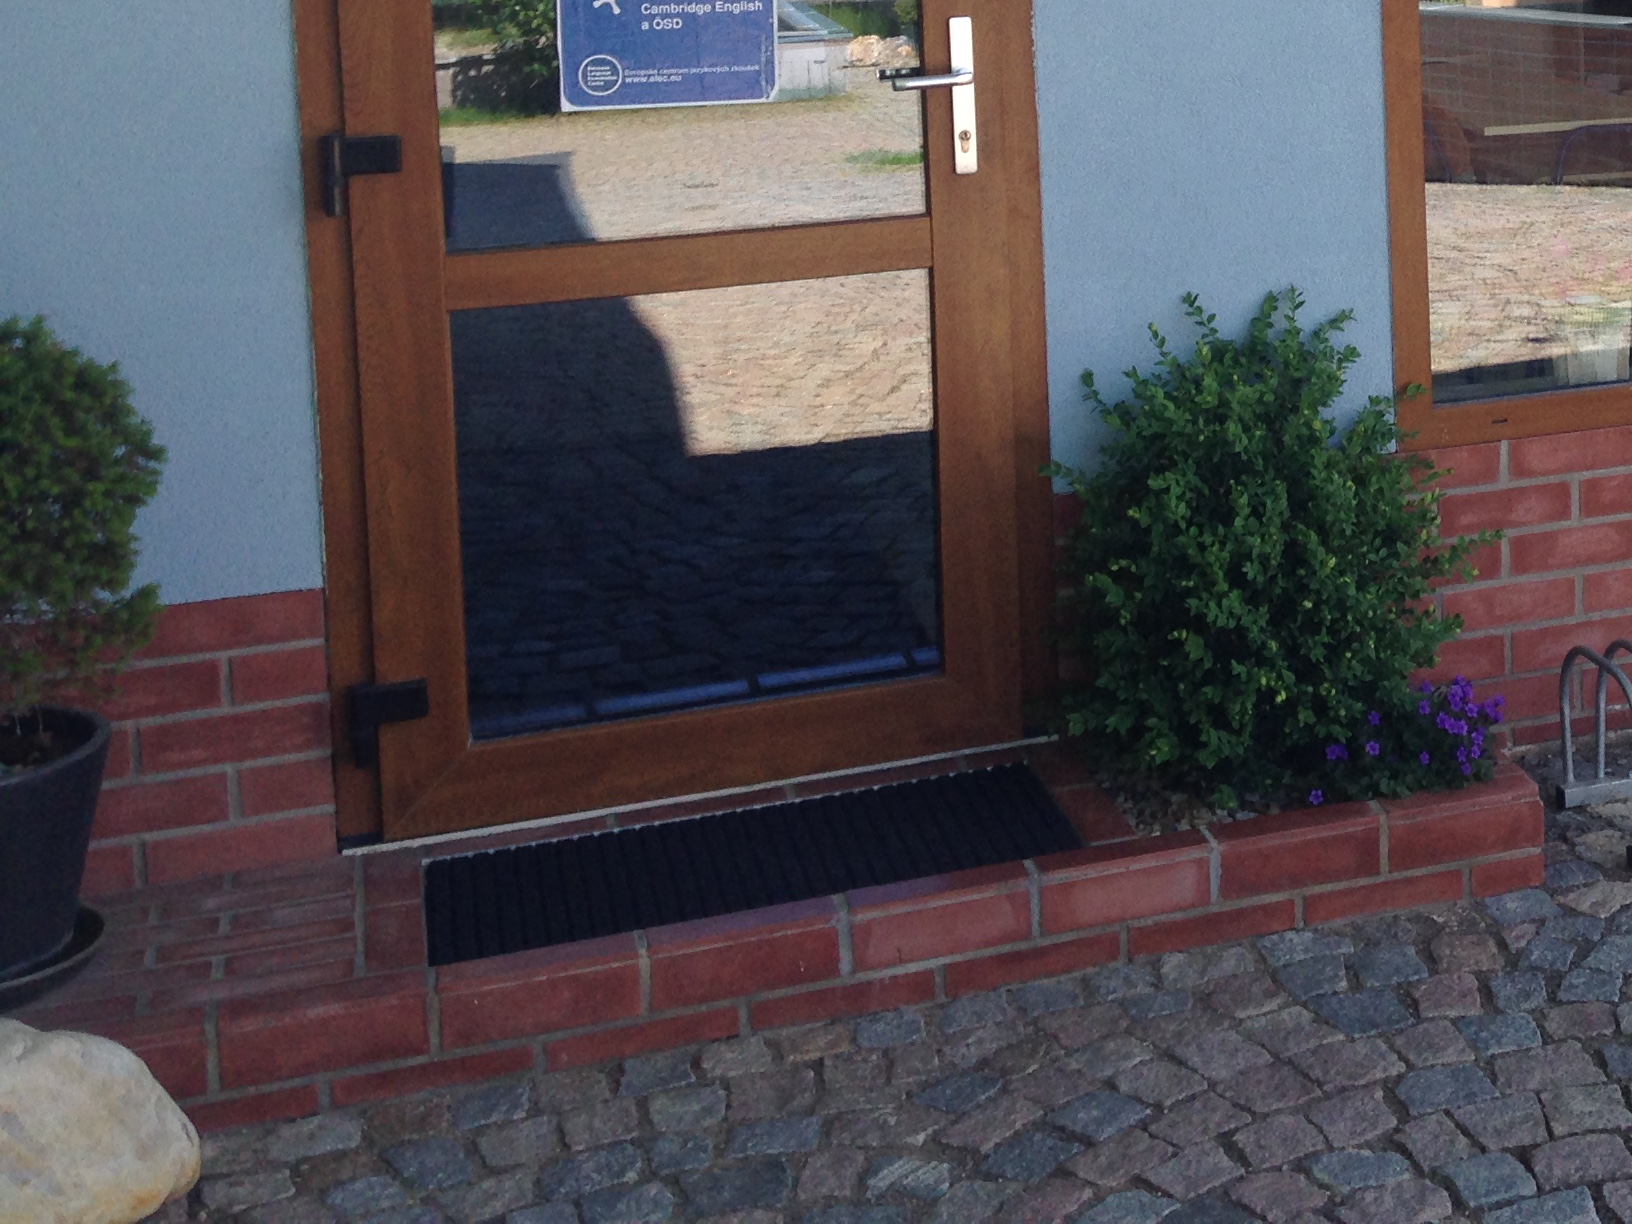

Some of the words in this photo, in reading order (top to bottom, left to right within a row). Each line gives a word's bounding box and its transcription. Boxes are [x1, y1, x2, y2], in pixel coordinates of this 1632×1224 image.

[641, 2, 712, 15] Cambridge
[715, 0, 763, 14] English
[641, 20, 650, 30] a
